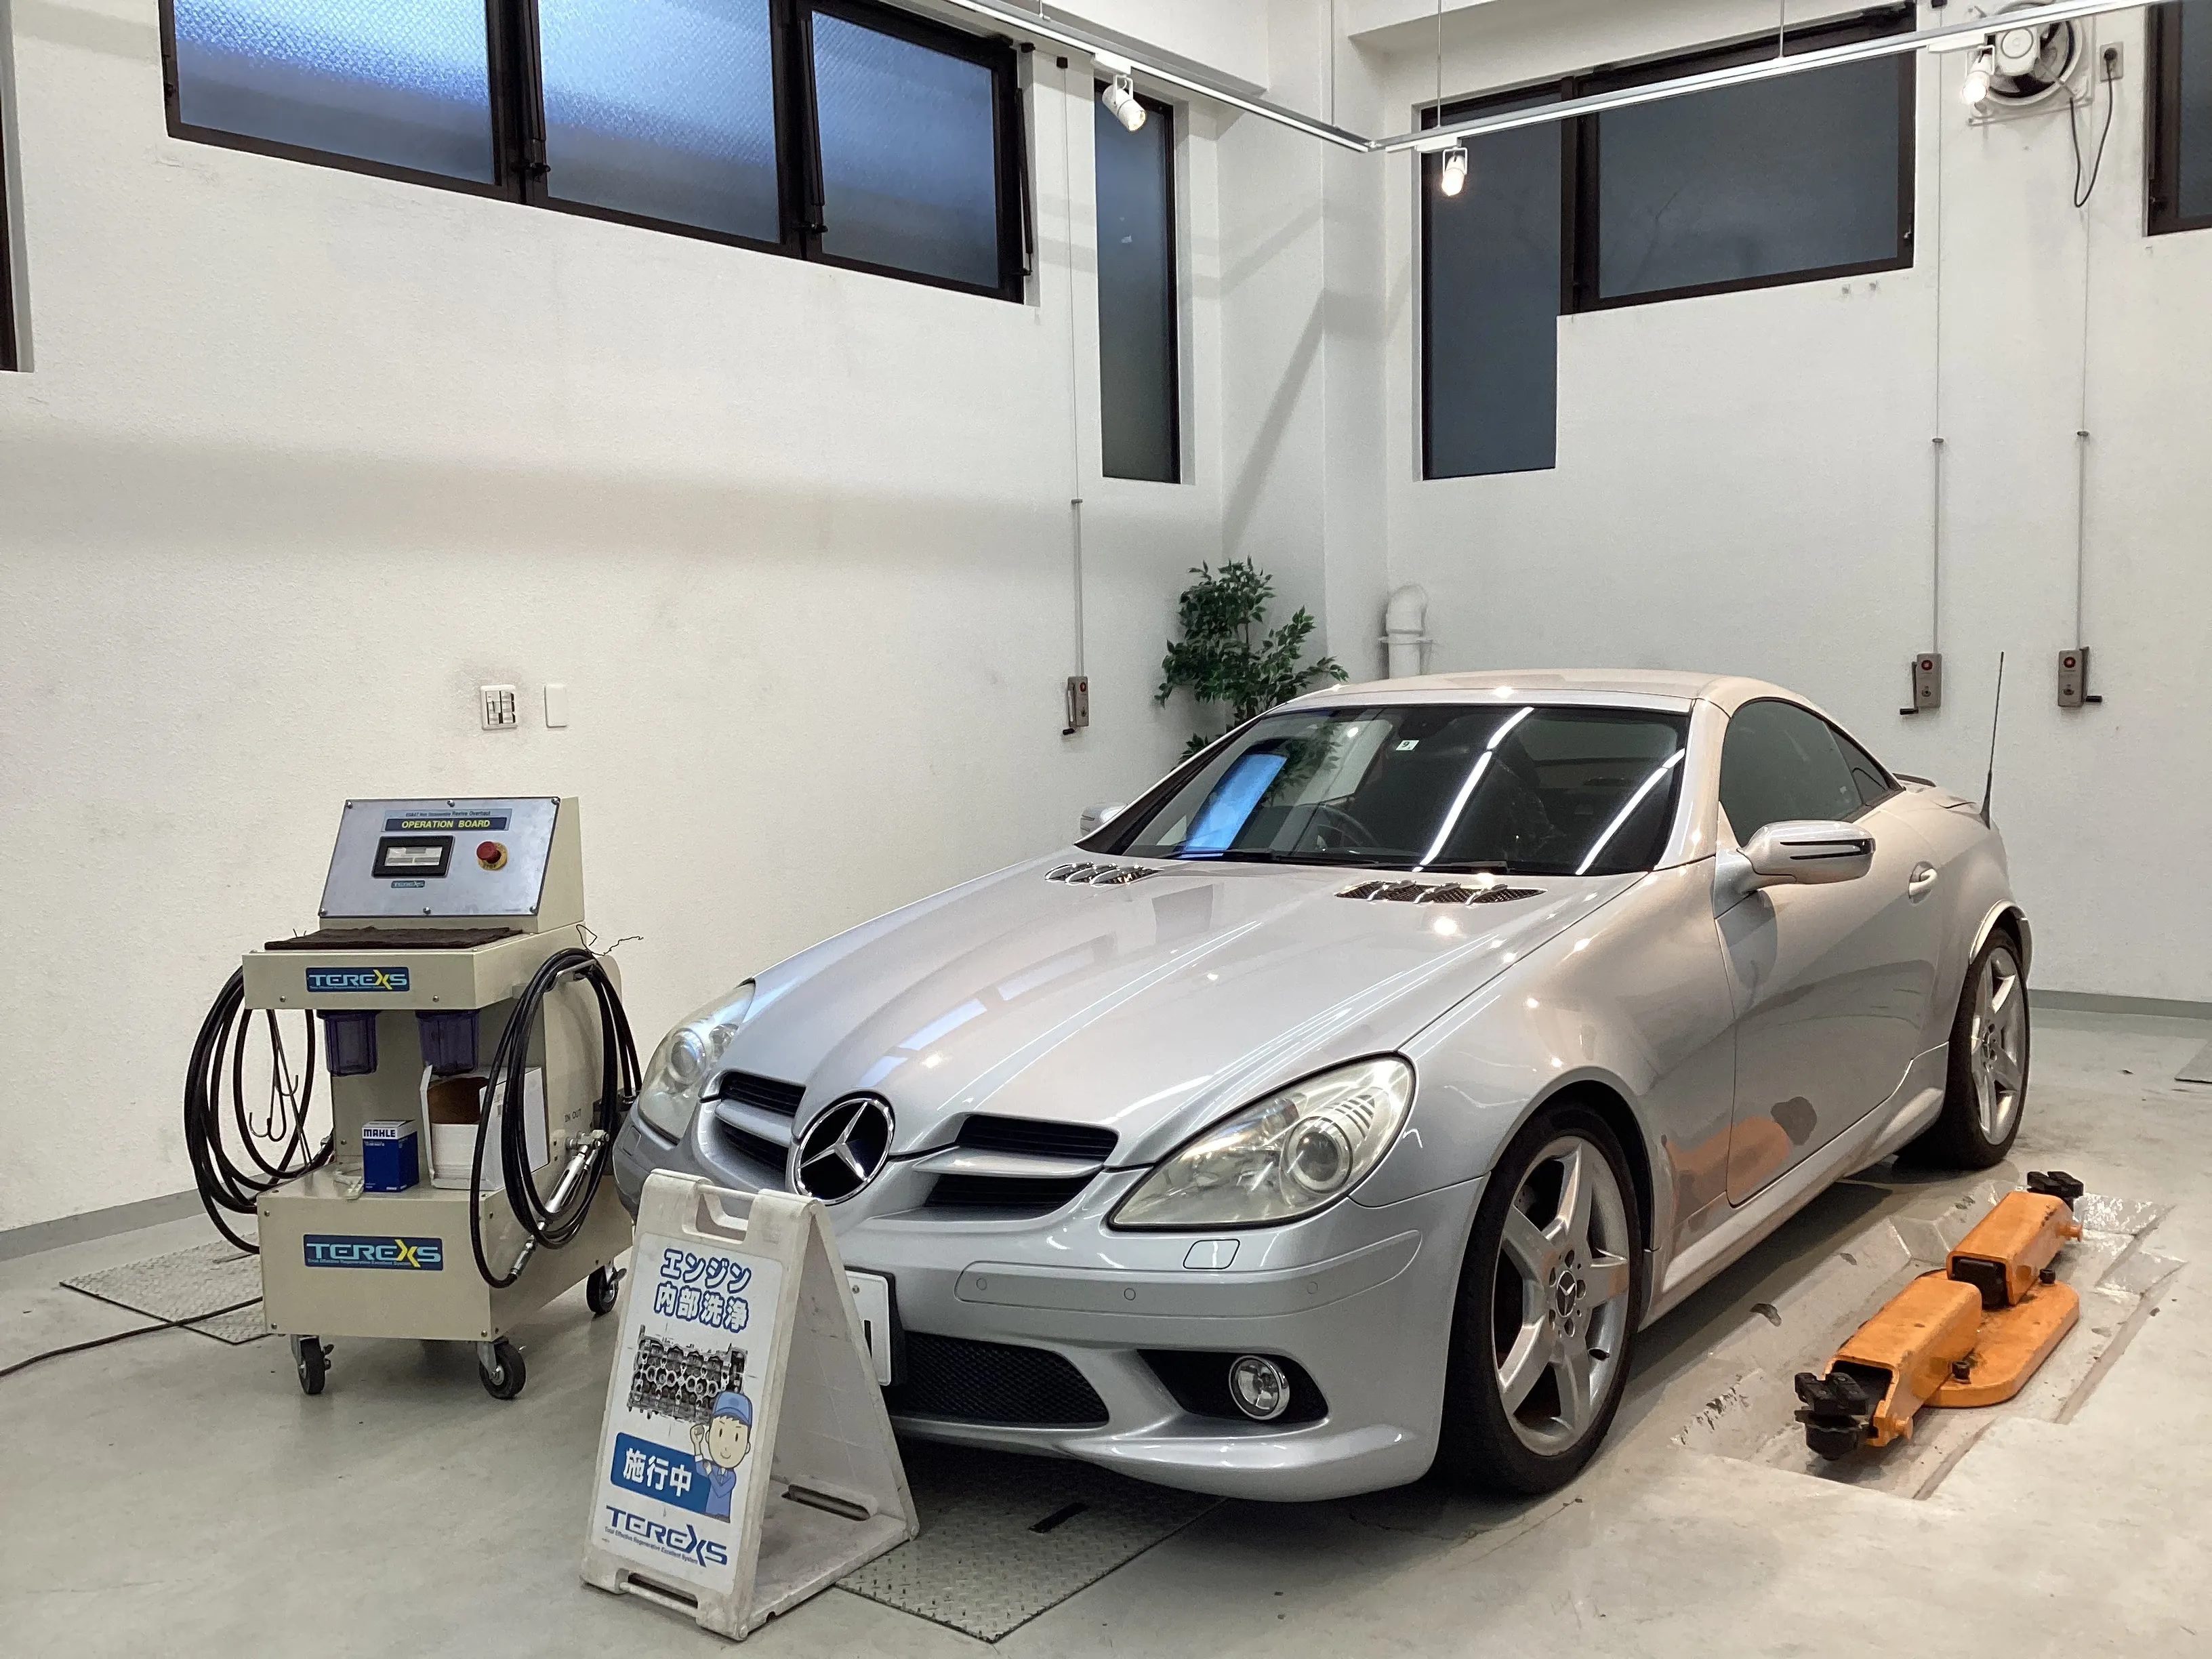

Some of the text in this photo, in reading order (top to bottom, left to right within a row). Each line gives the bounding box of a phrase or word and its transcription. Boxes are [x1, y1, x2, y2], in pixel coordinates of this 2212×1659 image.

[401, 819, 490, 828] OPERATION BOARD
[308, 969, 407, 990] TEREXS
[363, 1128, 396, 1138] MAHLE
[306, 1239, 441, 1268] TEREXS
[660, 1248, 752, 1294] エンジン
[653, 1281, 750, 1334] 内部洗浄
[623, 1447, 693, 1497] 施行中
[606, 1504, 728, 1568] TEREXS
